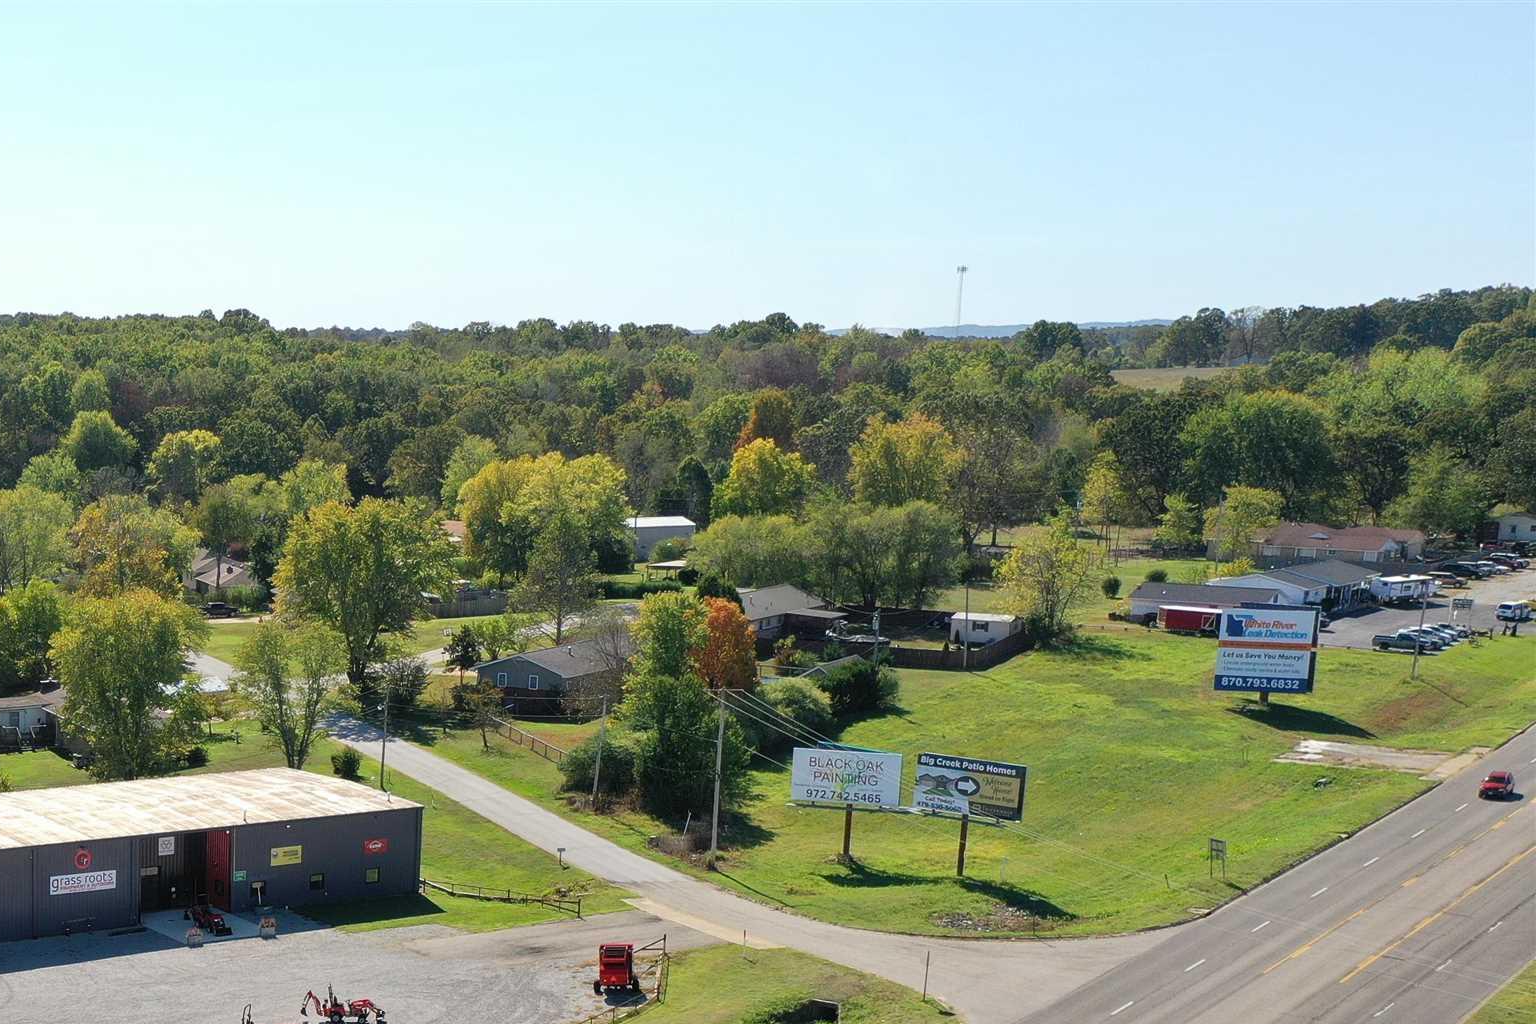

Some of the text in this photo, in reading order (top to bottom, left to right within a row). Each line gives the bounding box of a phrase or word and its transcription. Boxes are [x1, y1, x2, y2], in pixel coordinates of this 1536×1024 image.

[1272, 620, 1297, 630] River
[1265, 629, 1307, 639] Detection
[1245, 652, 1261, 660] Save
[1221, 676, 1300, 689] 870.793.6832
[809, 756, 884, 771] BLACK OAK
[920, 755, 1016, 776] Big Creek Patio Homes
[813, 771, 879, 787] PAINTING
[806, 788, 881, 804] 972.742.5465
[51, 875, 82, 892] grass
[84, 872, 113, 884] roots
